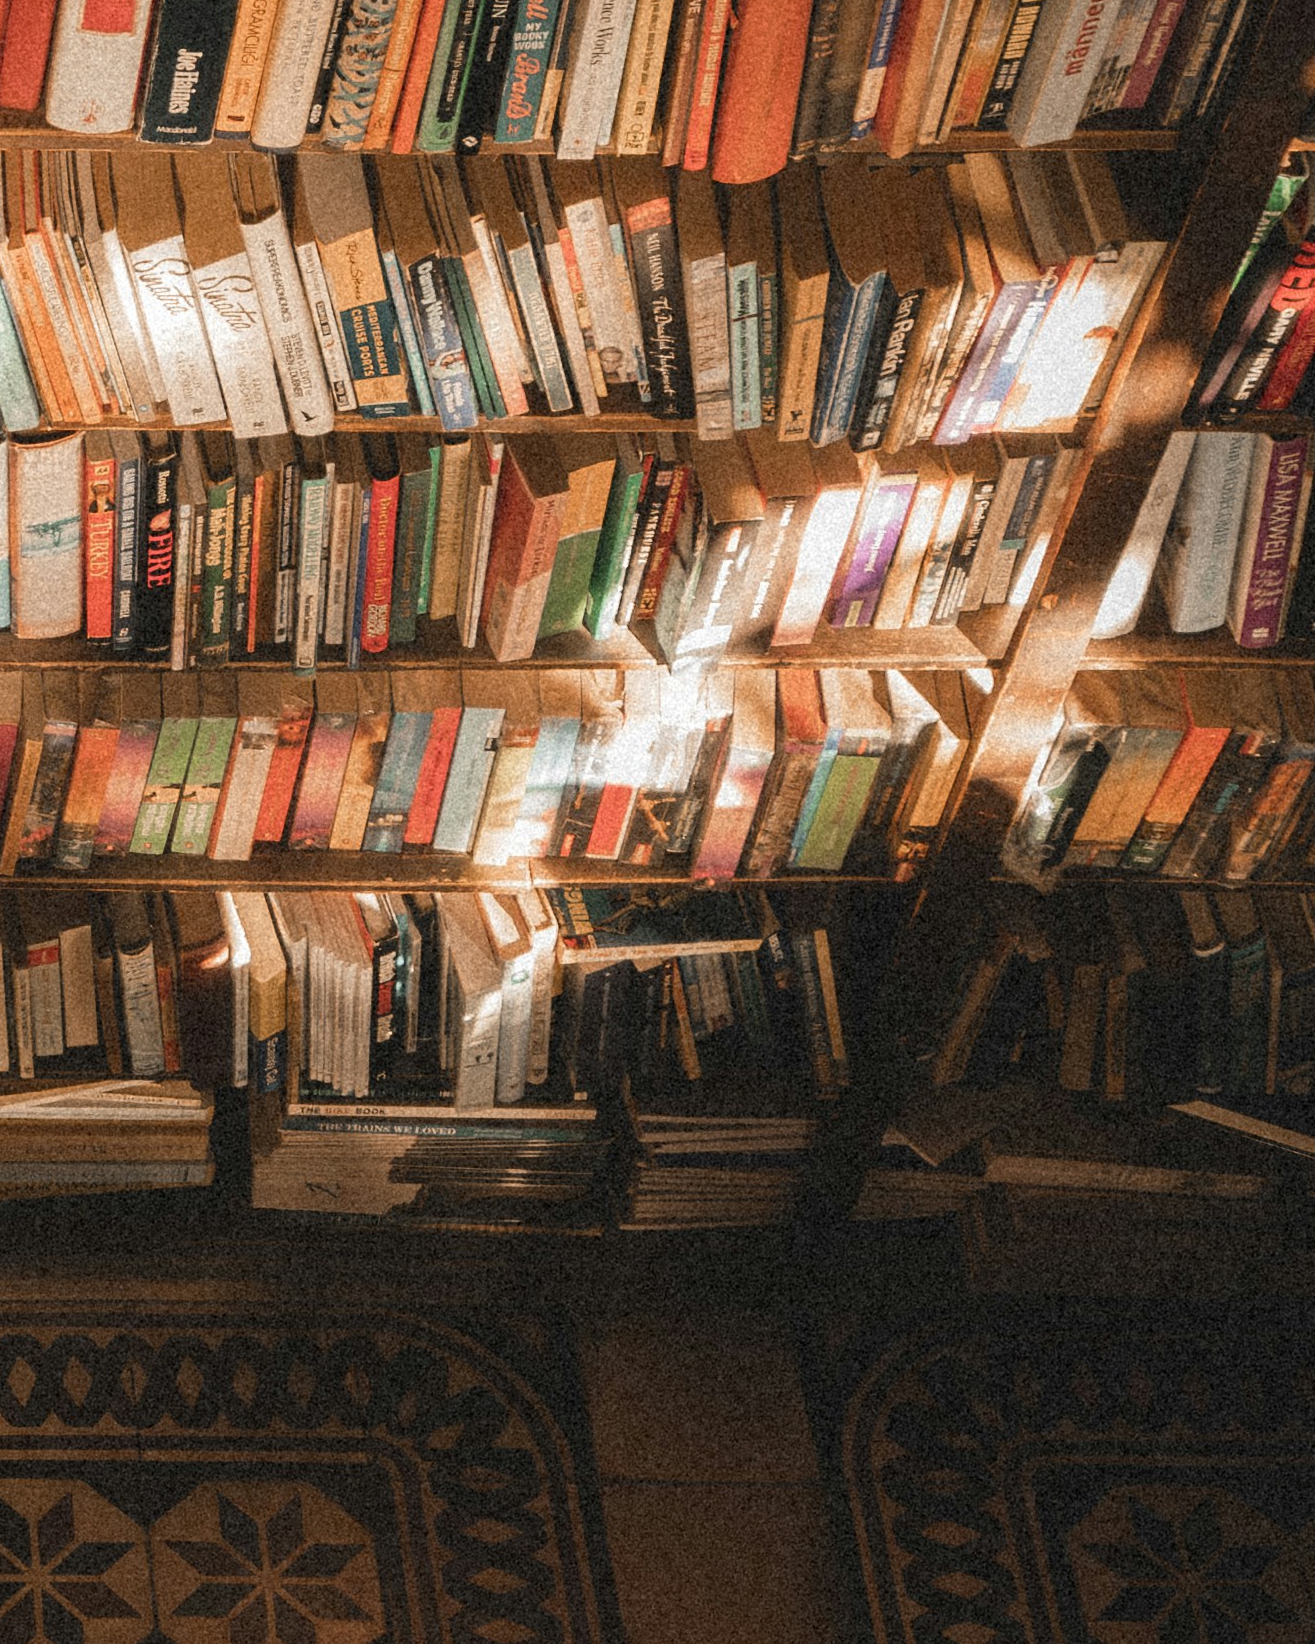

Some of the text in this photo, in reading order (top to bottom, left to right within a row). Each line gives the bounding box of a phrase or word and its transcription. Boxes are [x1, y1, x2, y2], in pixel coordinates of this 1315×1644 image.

[168, 38, 206, 109] Joe Haines
[506, 52, 551, 125] Brand
[1261, 448, 1303, 564] LISA MAXWELL
[88, 517, 112, 581] TURKEY
[144, 531, 174, 590] FIRE
